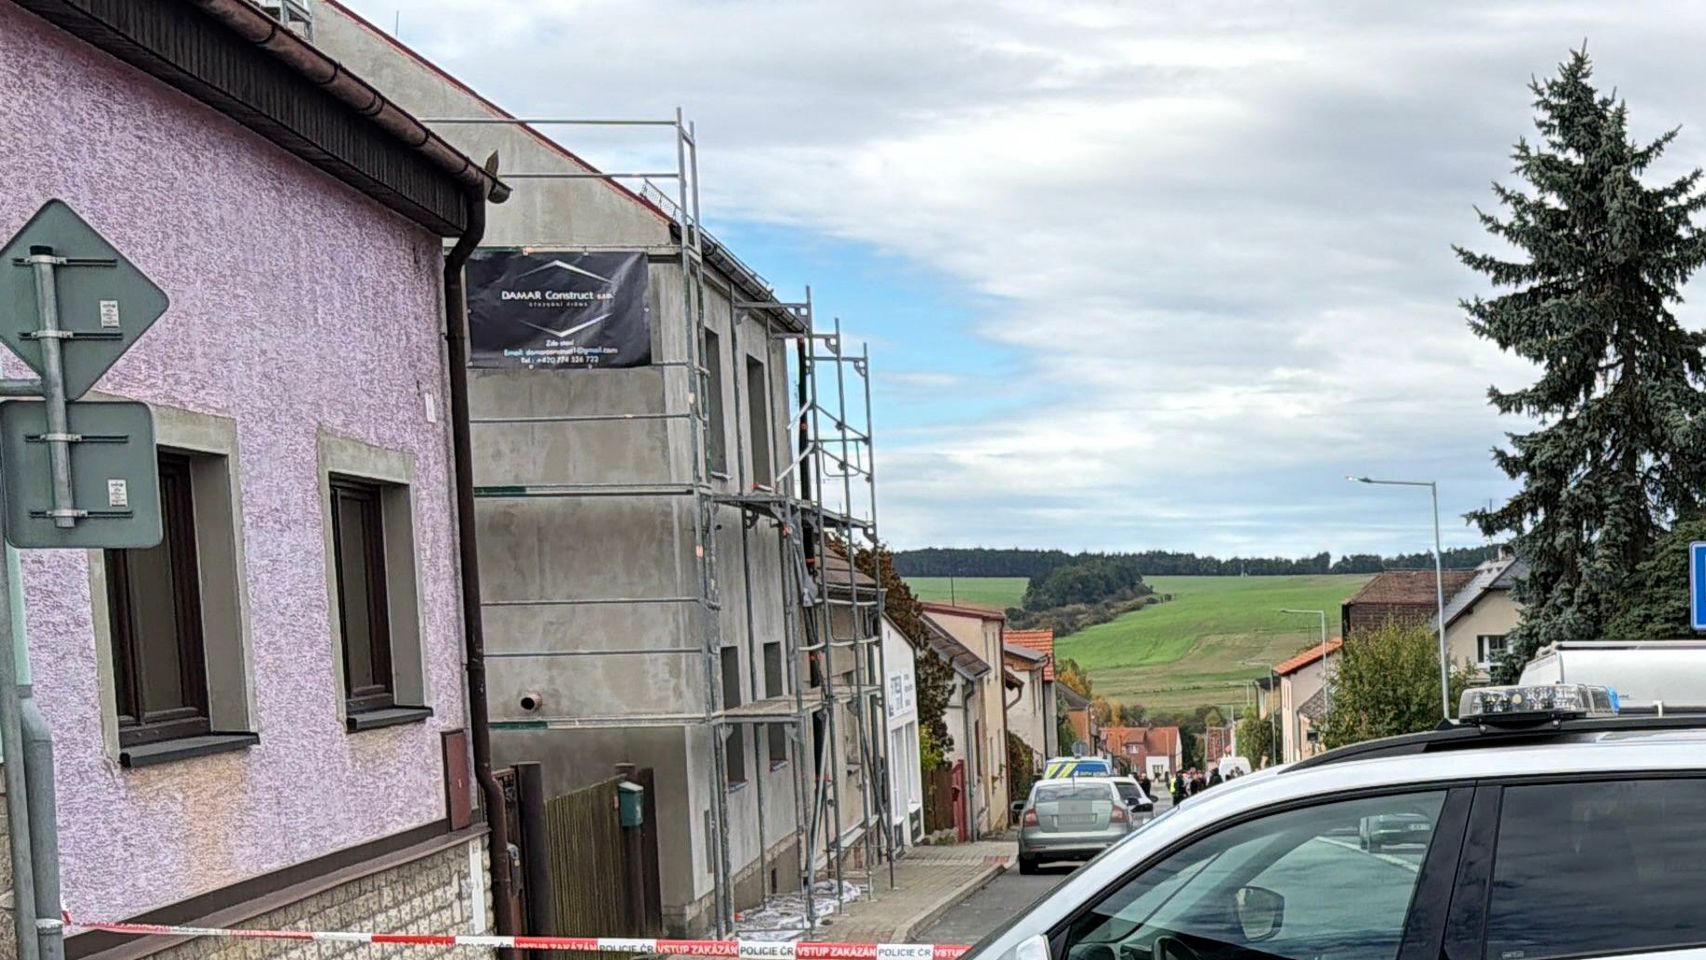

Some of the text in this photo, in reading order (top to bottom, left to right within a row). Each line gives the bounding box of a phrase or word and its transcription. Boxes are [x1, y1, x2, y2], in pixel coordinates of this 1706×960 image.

[501, 290, 542, 300] DAMAR
[545, 290, 594, 300] Construct
[657, 945, 690, 955] VSTUP
[691, 944, 737, 956] ZAKÁZÁN
[740, 946, 778, 956] POLICIE
[780, 945, 794, 956] ČR
[797, 946, 829, 957] VSTUP
[830, 946, 876, 957] ZAKÁZÁN
[878, 948, 914, 957] POLICIE
[917, 947, 931, 957] ČR
